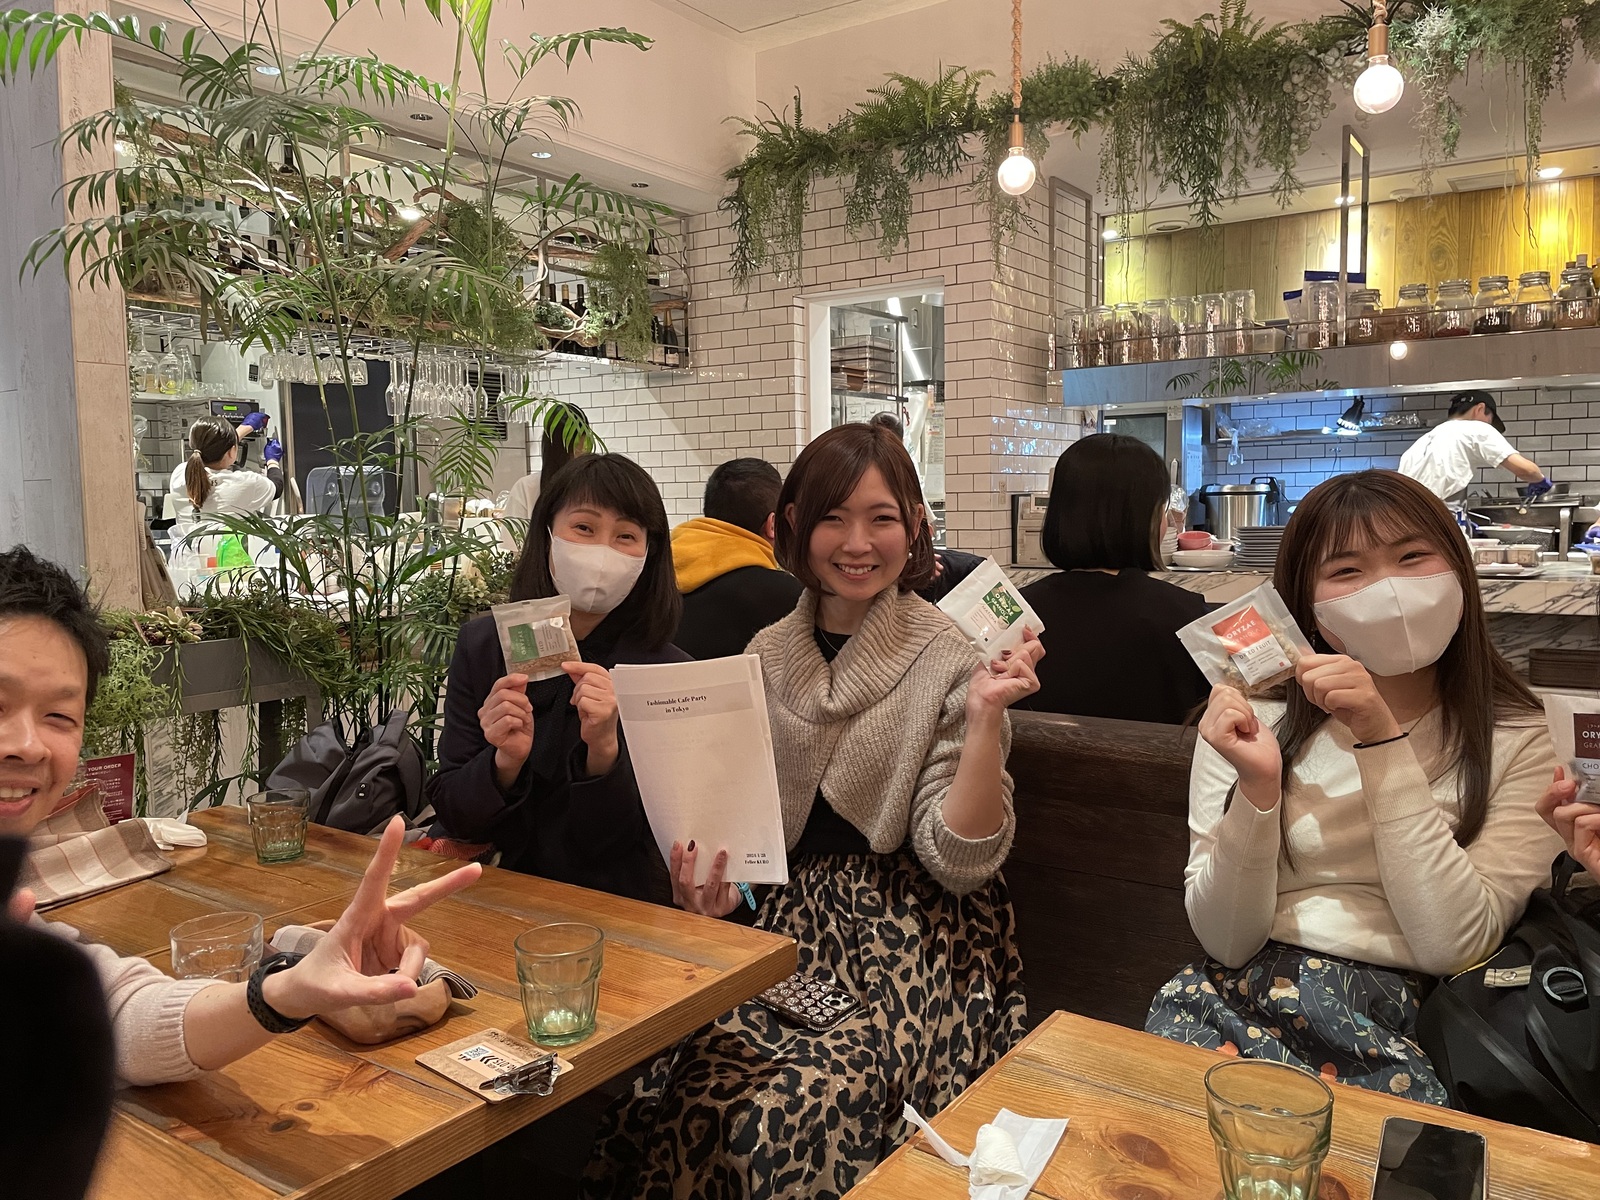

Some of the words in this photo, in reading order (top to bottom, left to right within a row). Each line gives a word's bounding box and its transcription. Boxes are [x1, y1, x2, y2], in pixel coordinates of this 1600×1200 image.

[982, 604, 997, 624] MATCHA
[990, 597, 1009, 620] GRANOLA
[994, 592, 1014, 616] ORYZAE
[1226, 620, 1256, 639] ORYZAE
[1238, 650, 1256, 660] DRED
[1256, 640, 1271, 651] FRUIT
